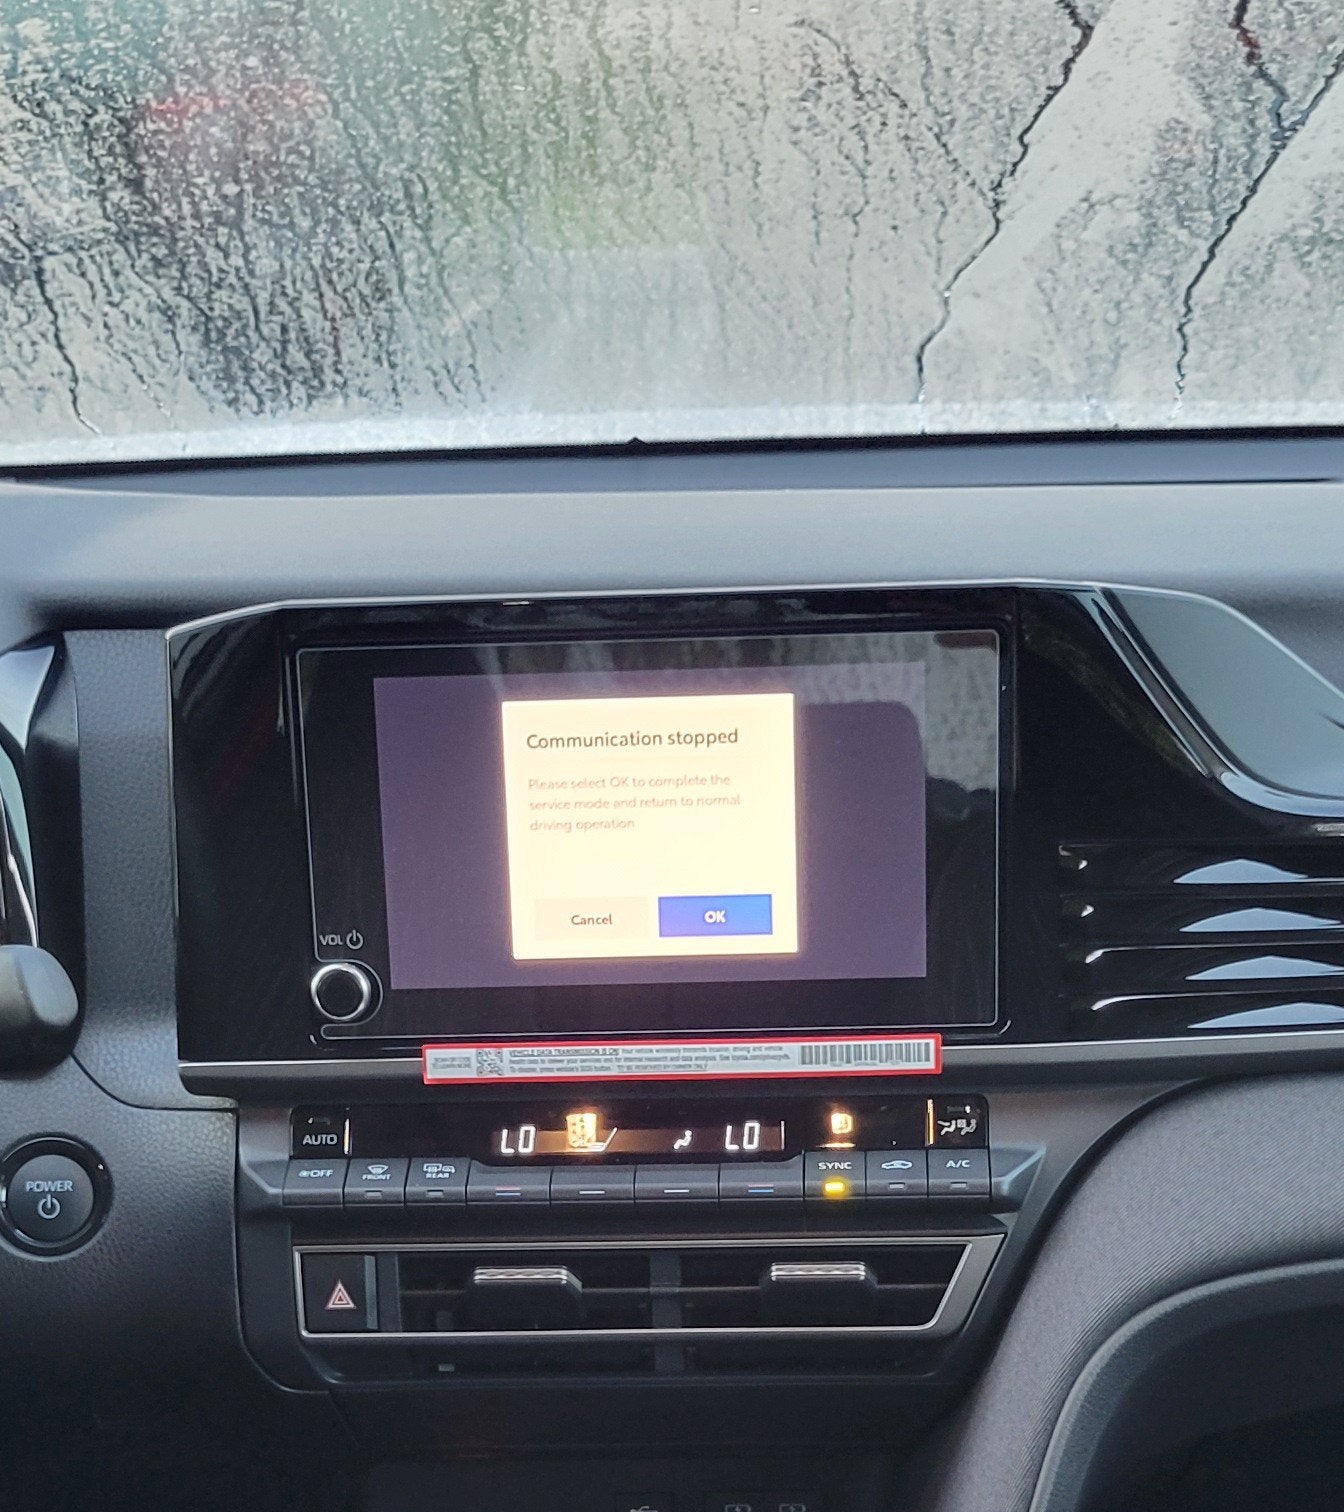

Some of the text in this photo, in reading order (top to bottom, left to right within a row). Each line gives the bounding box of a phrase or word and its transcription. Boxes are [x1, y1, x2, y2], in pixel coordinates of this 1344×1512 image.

[526, 727, 739, 749] Communication stopped
[528, 774, 730, 790] Please select OK to complete the
[530, 794, 740, 810] service mode and return to normal
[530, 820, 572, 833] driving
[571, 910, 727, 926] Cancel OK
[319, 934, 343, 946] VOL
[302, 1134, 338, 1146] AUTO
[500, 1121, 761, 1154] LO LO
[818, 1162, 853, 1171] SYNC
[945, 1160, 971, 1169] A/C
[310, 1169, 334, 1178] OFF
[362, 1173, 392, 1181] FRONT
[25, 1181, 74, 1192] POWER
